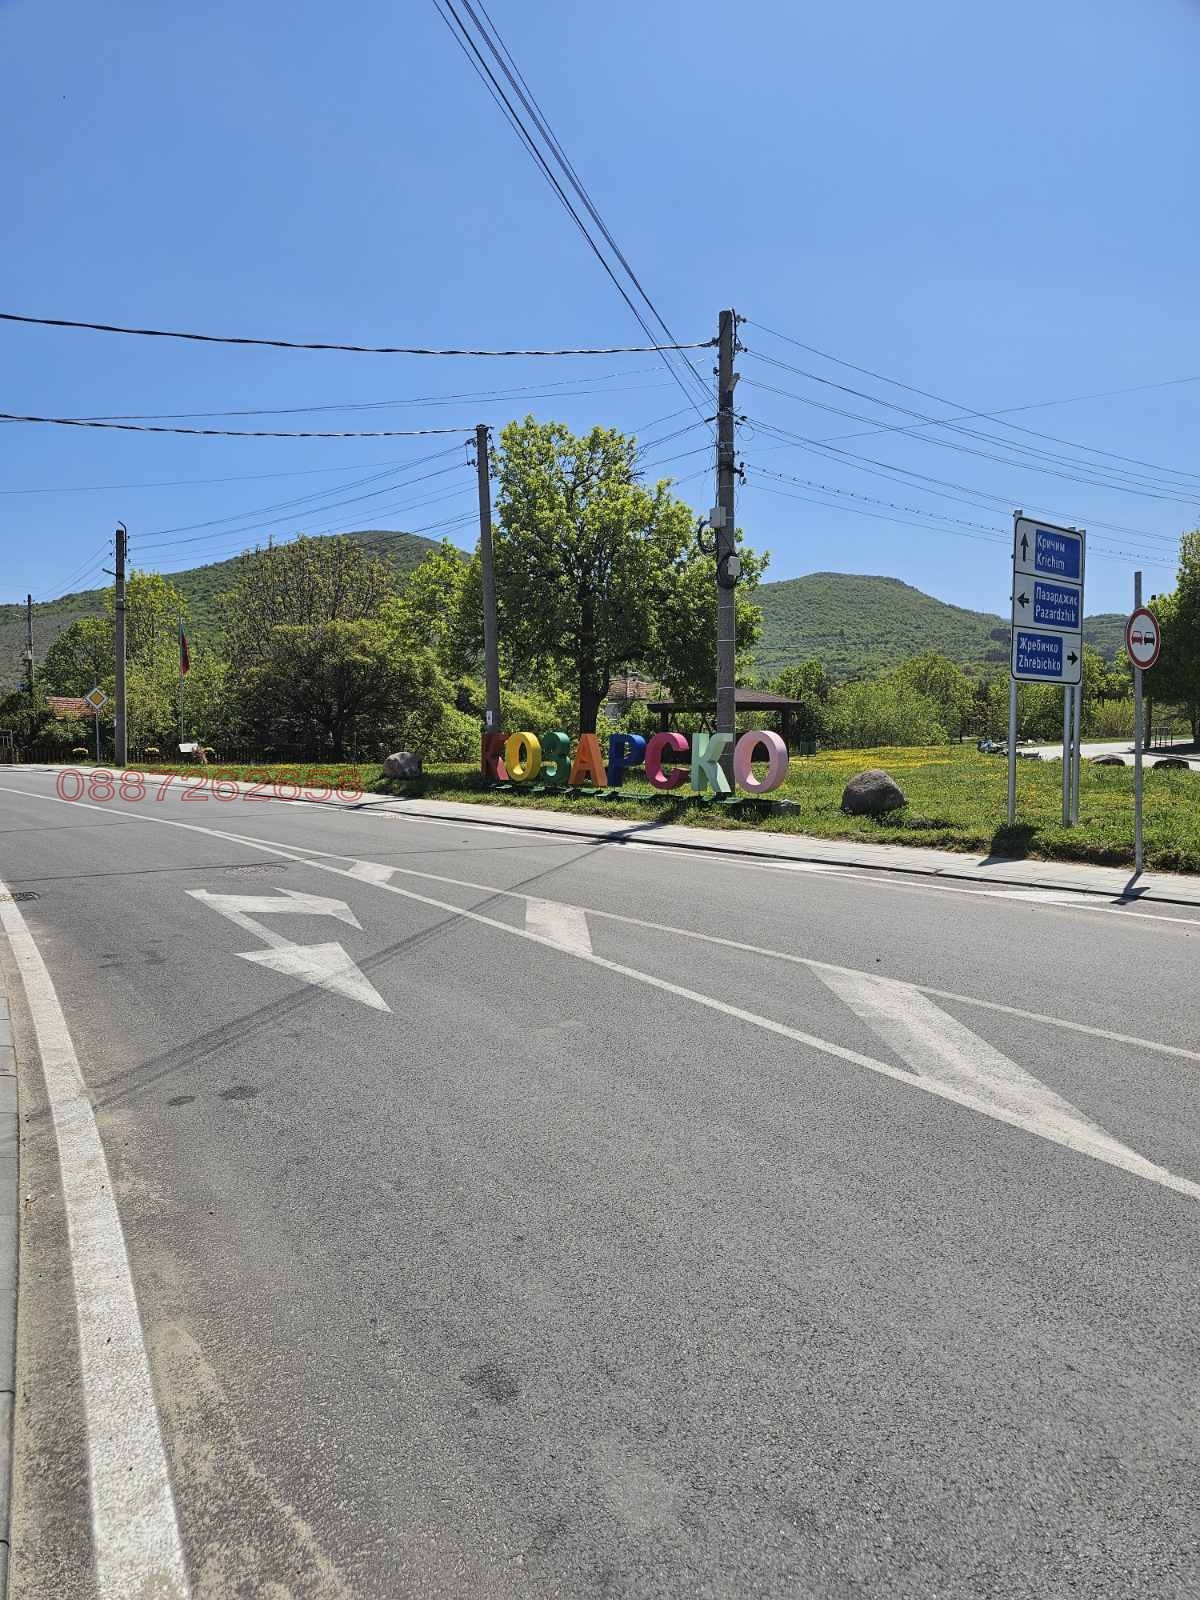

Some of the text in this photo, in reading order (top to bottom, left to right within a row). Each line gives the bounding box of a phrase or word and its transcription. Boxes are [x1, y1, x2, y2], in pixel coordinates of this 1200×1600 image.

[1037, 535, 1065, 553] Кричим
[1036, 552, 1065, 570] Krichim
[1036, 586, 1078, 606] Пазарджик
[1035, 604, 1076, 622] Pazardzhik
[1019, 637, 1059, 653] Жребичко
[1018, 654, 1061, 671] Zhrebichko
[480, 730, 788, 794] КОЗАРСКО
